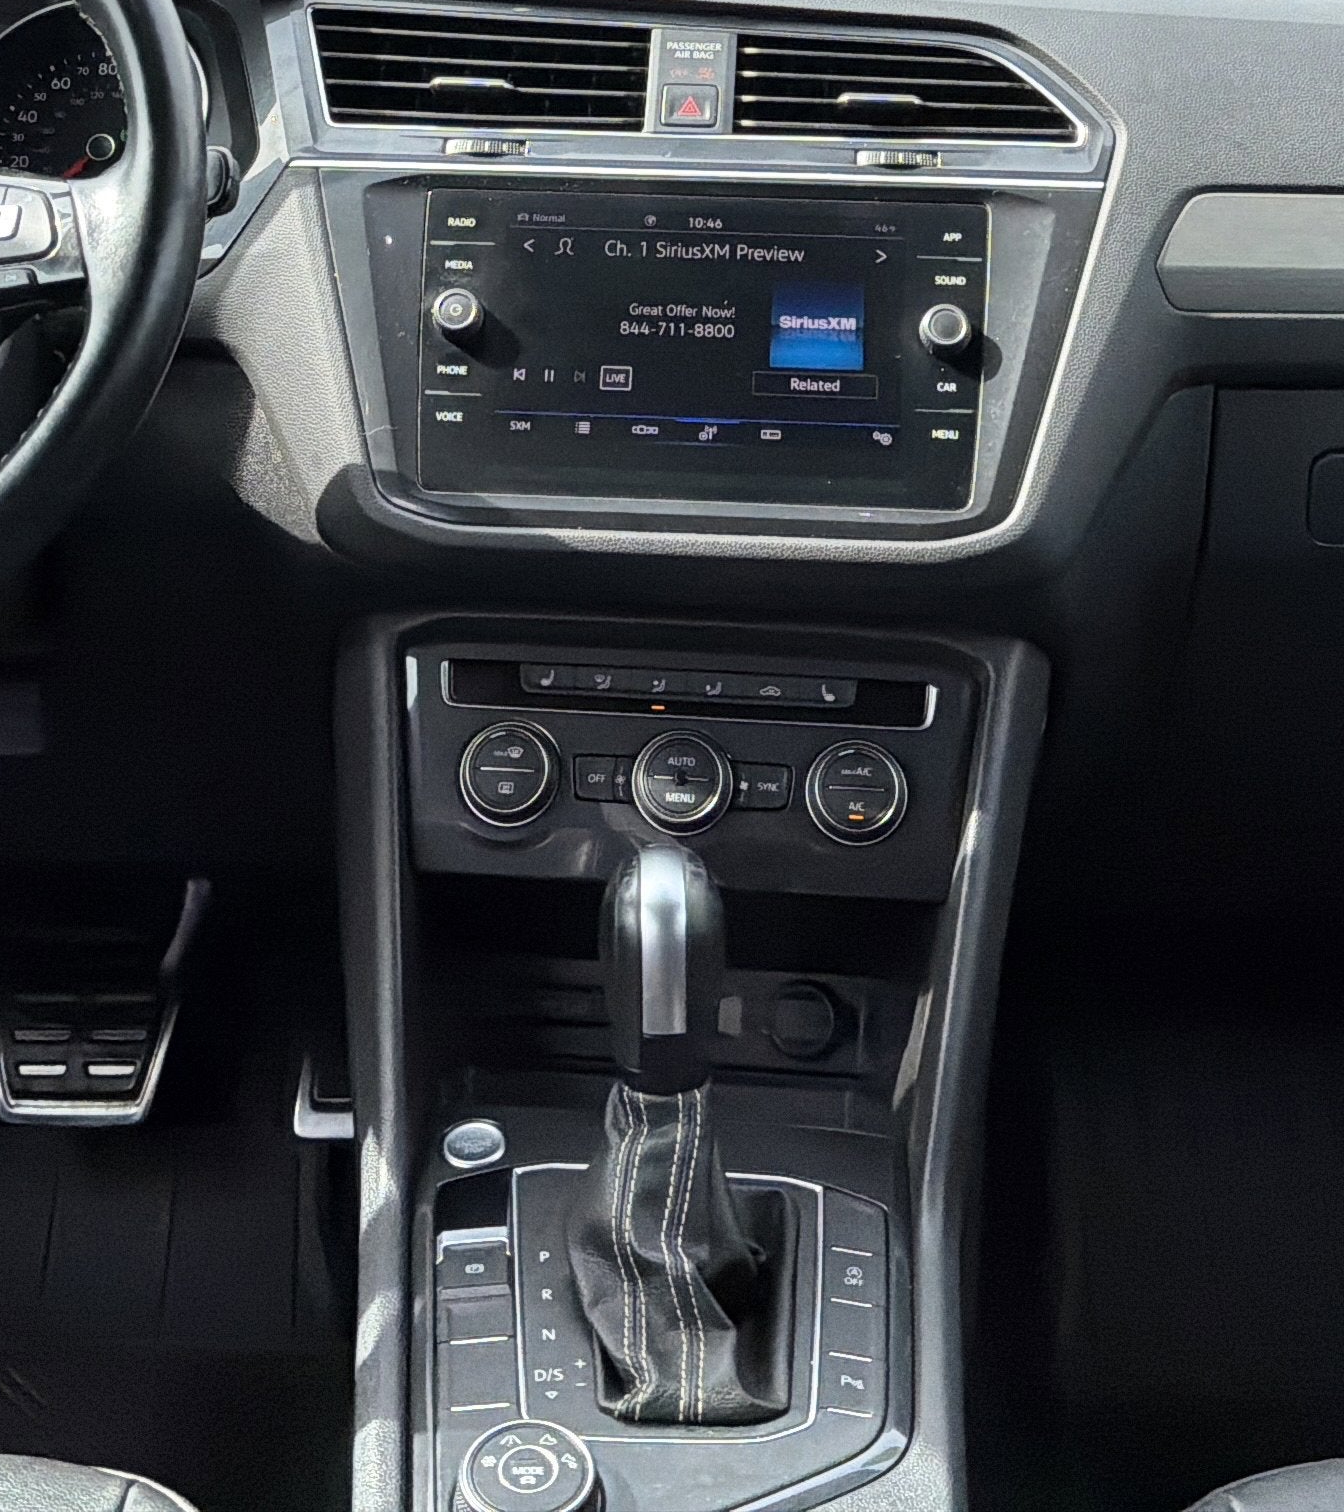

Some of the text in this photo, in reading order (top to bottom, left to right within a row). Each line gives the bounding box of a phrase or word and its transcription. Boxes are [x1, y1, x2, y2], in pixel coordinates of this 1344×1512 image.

[666, 41, 722, 51] PASSENGER
[674, 50, 714, 60] AIR BAG
[76, 66, 90, 76] 70
[98, 62, 118, 76] 80
[50, 76, 71, 90] 60
[33, 91, 47, 102] 50
[17, 110, 38, 124] 40
[11, 132, 25, 142] 30
[10, 155, 30, 169] 20
[447, 216, 477, 228] RADIO
[532, 212, 567, 224] Normal
[687, 217, 723, 230] 10:46
[942, 232, 963, 243] APP
[604, 239, 805, 263] Ch. 1 SiriusXM Preview
[444, 259, 474, 271] MEDIA
[934, 275, 967, 286] SOUND
[629, 302, 736, 319] Great Offer Now!
[619, 321, 735, 338] 844-711-8800
[778, 315, 857, 332] SiriusXM
[436, 364, 468, 376] PHONE
[606, 373, 626, 384] LIVE
[790, 377, 841, 393] Related
[936, 382, 958, 393] CAR
[435, 411, 464, 422] VOICE
[509, 420, 532, 432] SXM
[931, 429, 960, 441] MENU
[667, 756, 697, 768] AUTO
[587, 773, 606, 784] OFF
[756, 782, 781, 793] SYNC
[664, 791, 696, 804] MENU
[848, 801, 866, 812] A/C
[539, 1250, 551, 1263] P
[541, 1288, 553, 1301] R
[541, 1328, 557, 1341] N
[533, 1367, 565, 1383] D/S
[511, 1466, 545, 1476] MODE
